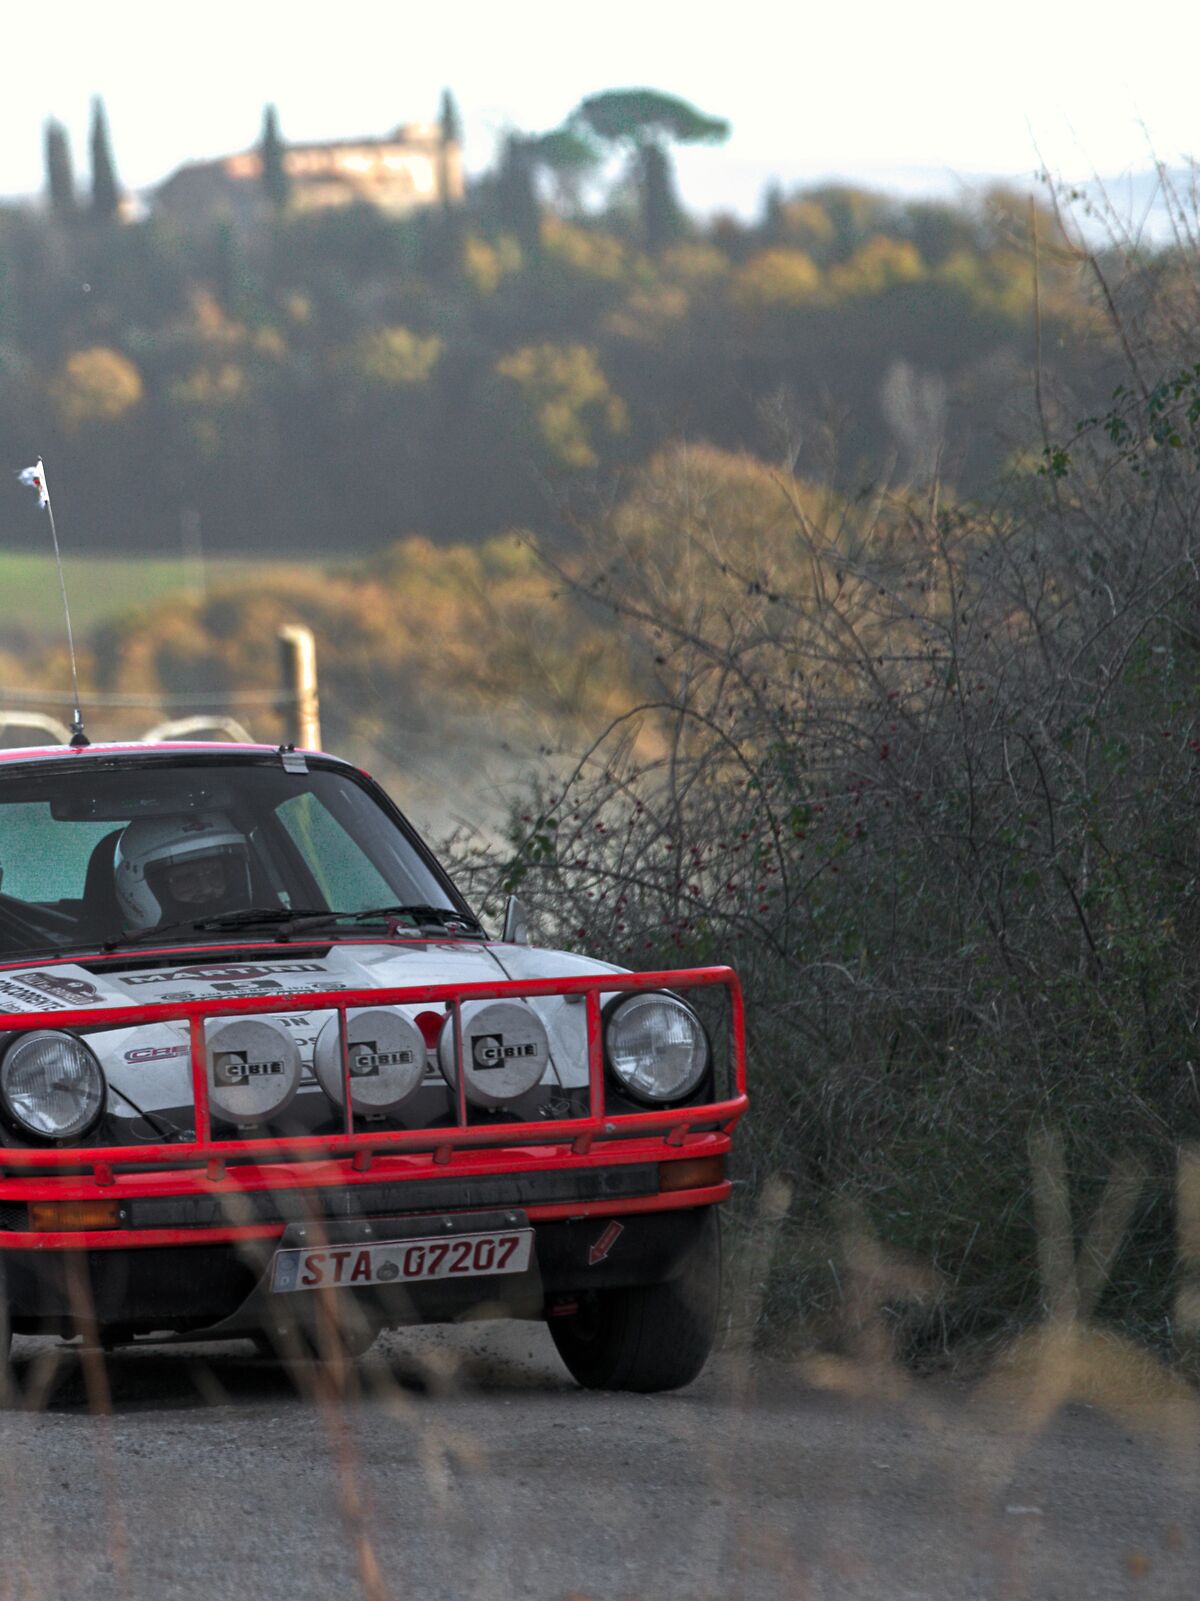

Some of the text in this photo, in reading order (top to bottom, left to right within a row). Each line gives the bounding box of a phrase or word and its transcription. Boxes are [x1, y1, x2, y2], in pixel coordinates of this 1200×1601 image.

[132, 964, 318, 984] MARTINI
[302, 1251, 372, 1285] STA
[403, 1237, 519, 1277] 07207
